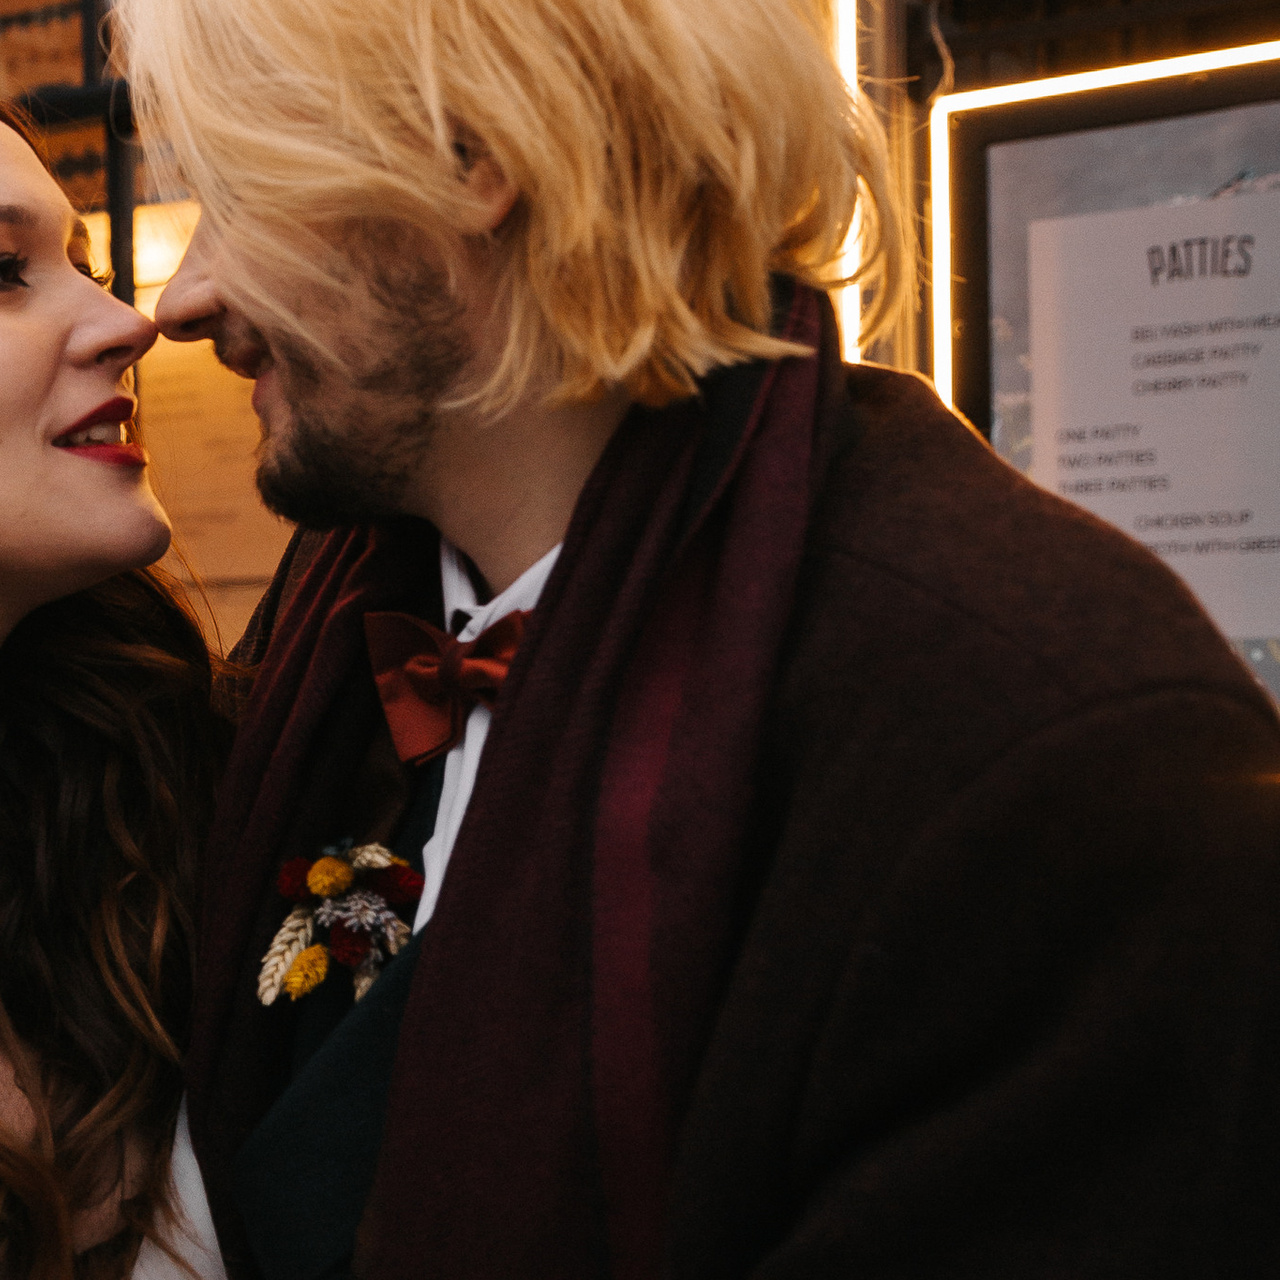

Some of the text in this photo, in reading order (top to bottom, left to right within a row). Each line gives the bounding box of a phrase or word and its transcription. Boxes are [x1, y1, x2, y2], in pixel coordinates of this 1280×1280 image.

[1146, 233, 1255, 287] PATTIES
[1131, 341, 1261, 369] CABBAGE PATTY
[1197, 370, 1248, 389] PATTY
[1056, 422, 1141, 443] ONE PATTY
[1057, 448, 1156, 469] TWO PATTIES
[1058, 474, 1170, 495] THREE PATTIES
